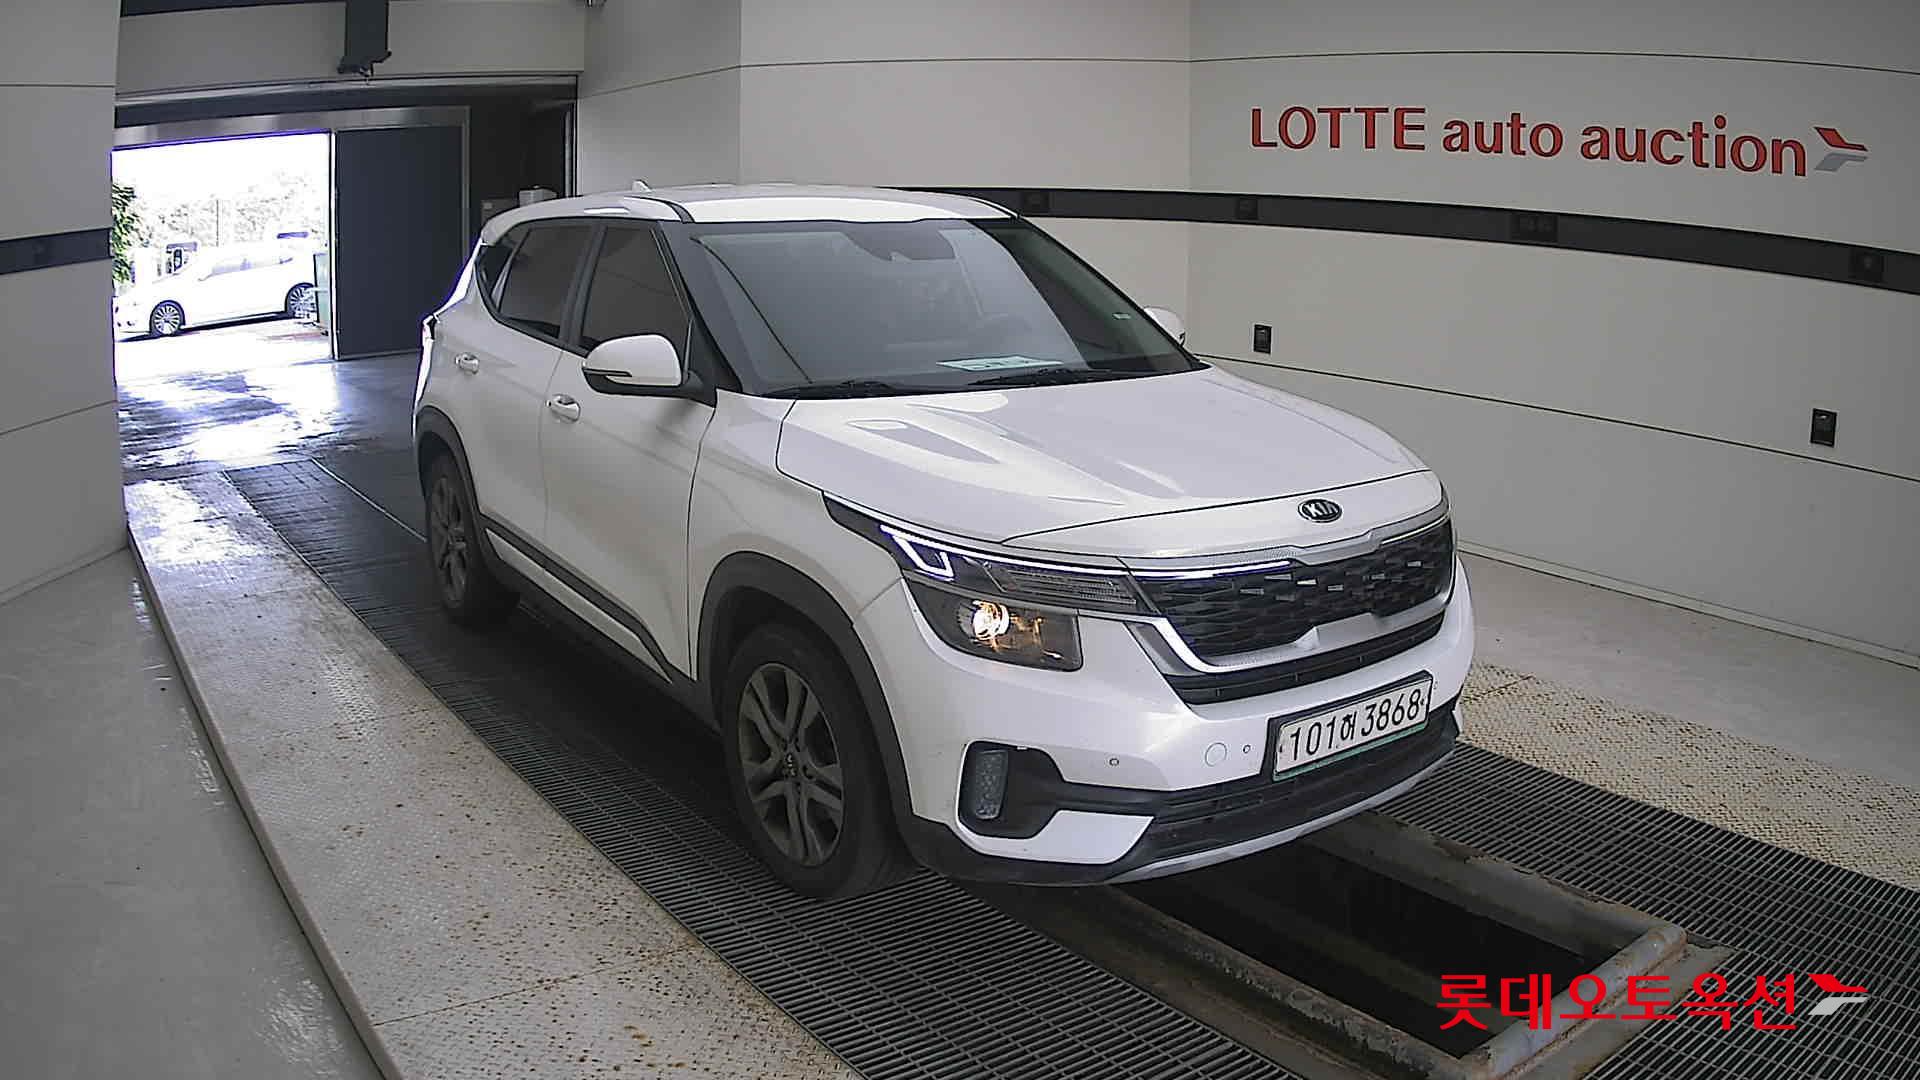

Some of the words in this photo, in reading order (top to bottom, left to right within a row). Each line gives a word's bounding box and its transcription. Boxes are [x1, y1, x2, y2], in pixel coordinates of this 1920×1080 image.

[1252, 107, 1426, 151] LOTTE
[1443, 112, 1563, 157] auto
[1580, 115, 1807, 177] auction
